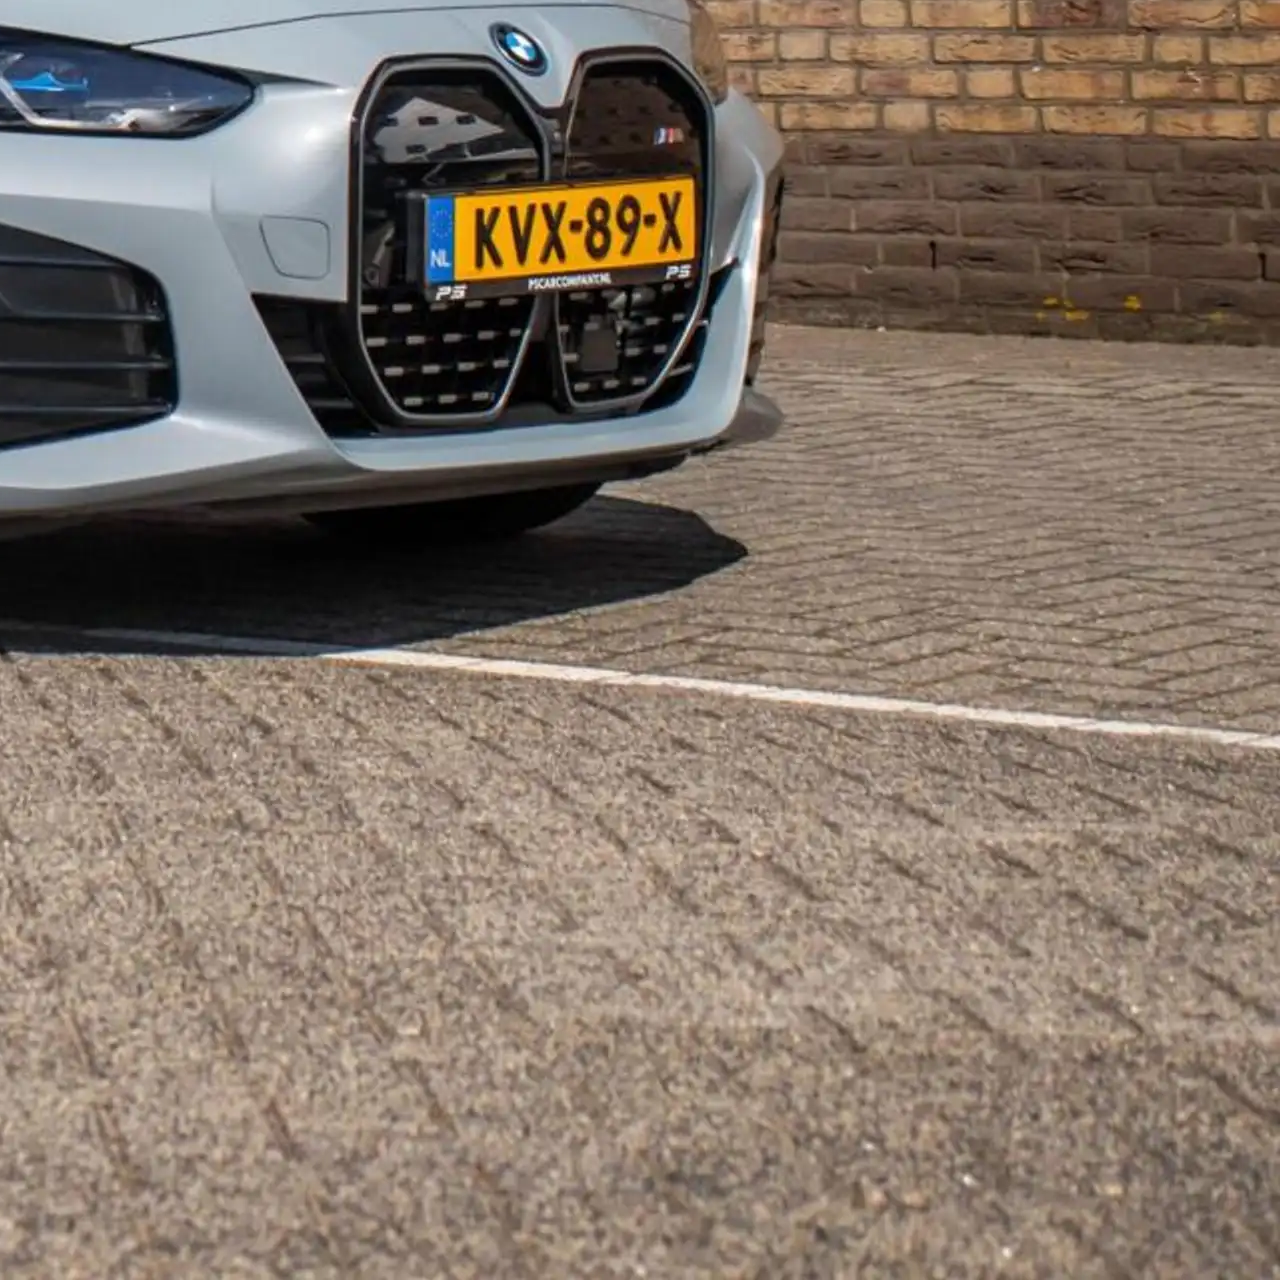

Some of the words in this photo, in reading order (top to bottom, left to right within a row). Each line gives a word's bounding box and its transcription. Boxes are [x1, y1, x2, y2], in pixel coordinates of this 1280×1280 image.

[475, 192, 683, 269] KVX-89-X
[430, 249, 451, 268] NL
[665, 264, 692, 280] PS
[435, 284, 468, 301] PS
